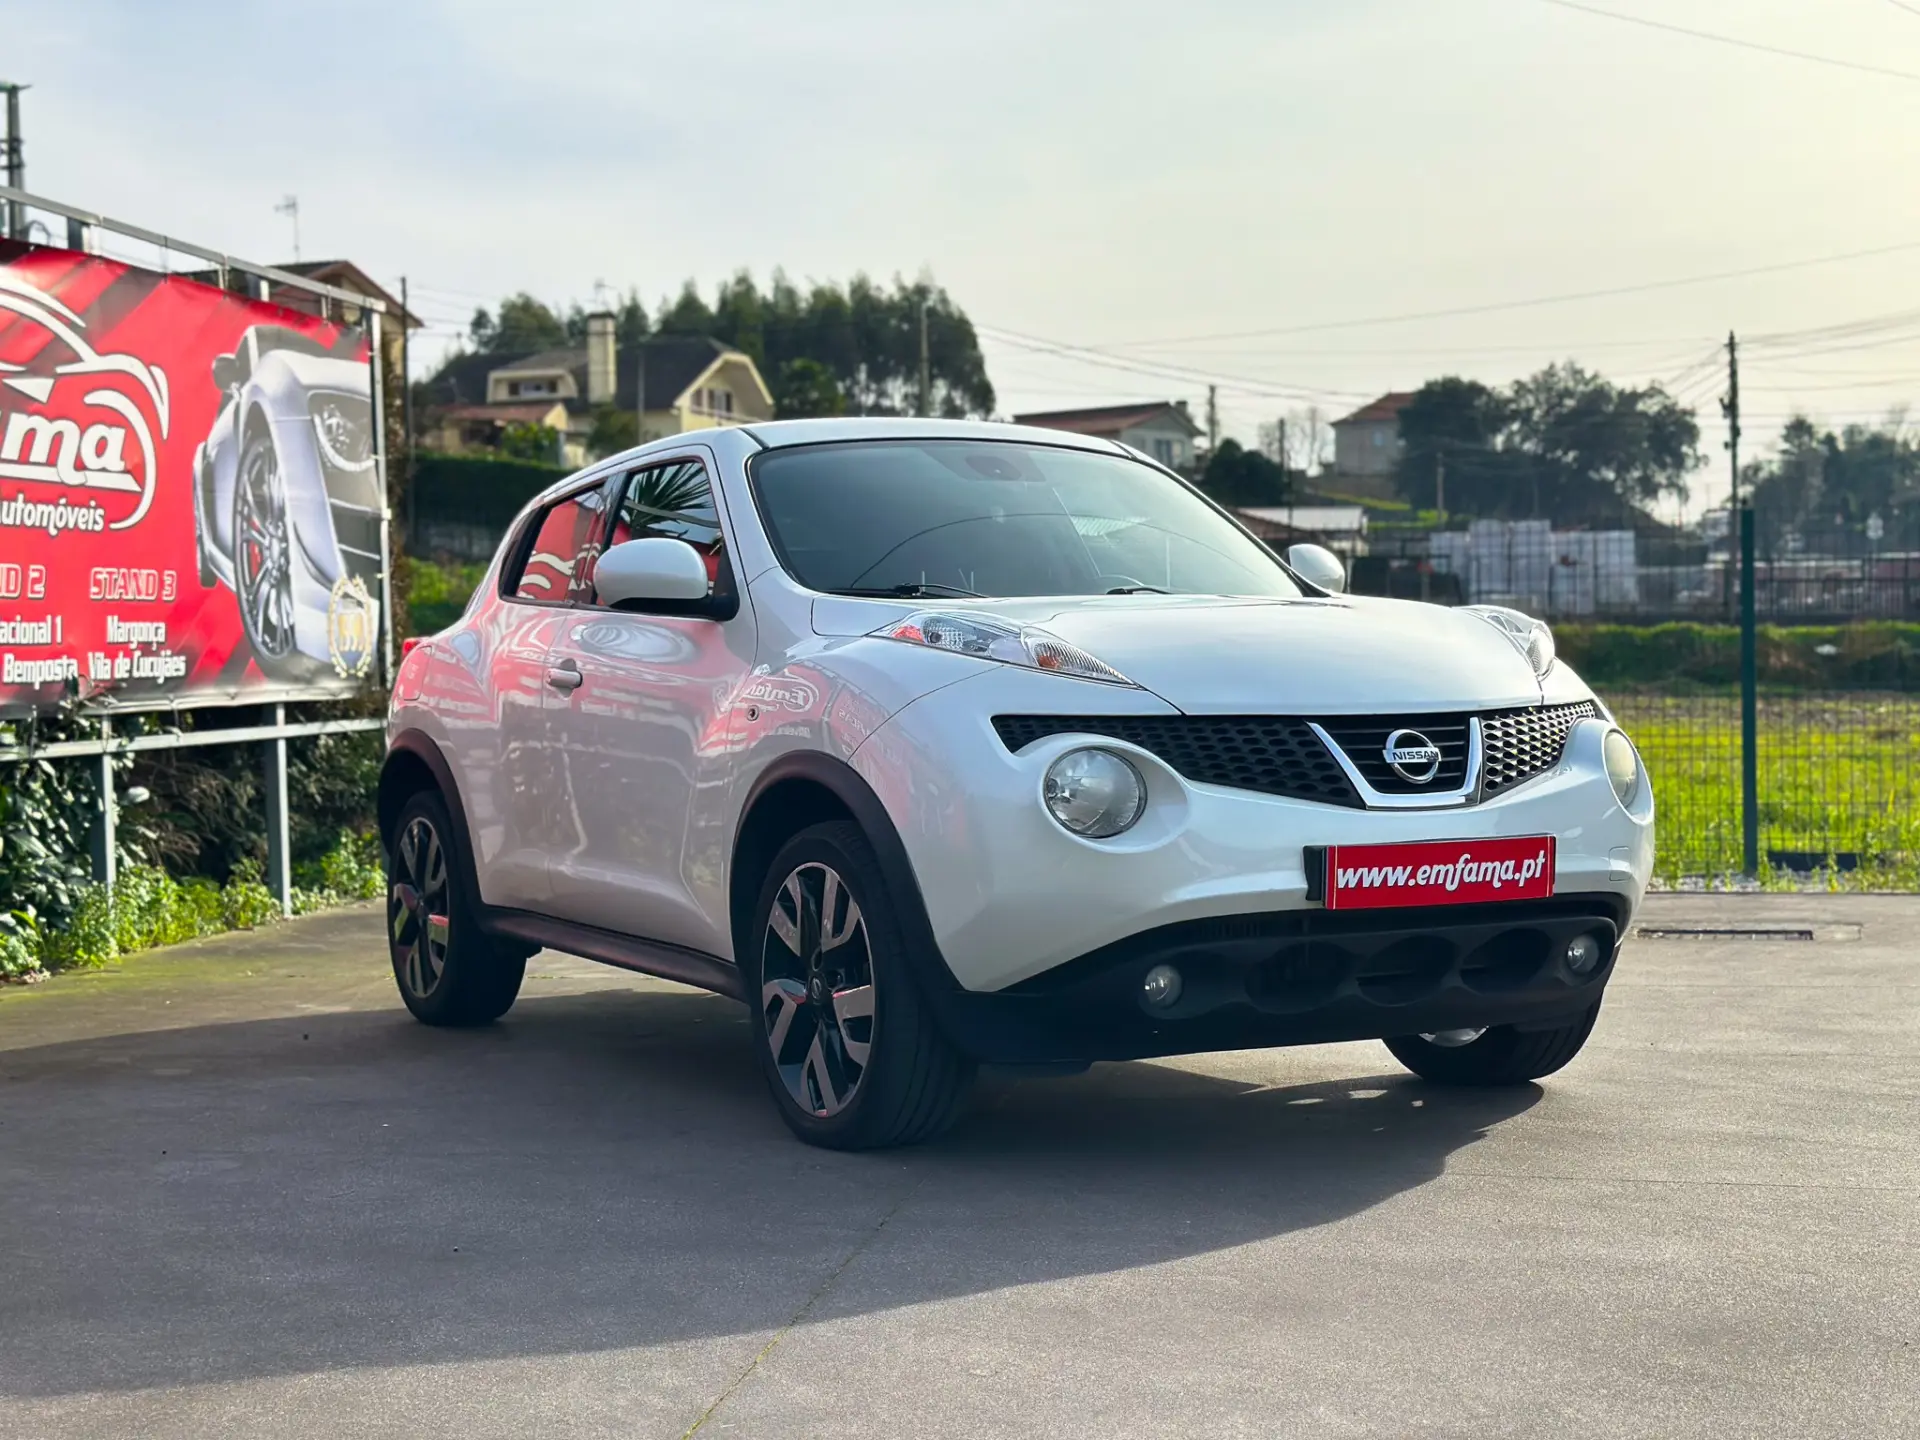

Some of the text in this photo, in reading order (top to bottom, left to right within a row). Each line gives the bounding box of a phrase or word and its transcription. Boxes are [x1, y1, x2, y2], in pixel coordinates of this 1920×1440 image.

[0, 410, 127, 486] ma
[0, 493, 104, 536] utomóveis
[27, 564, 46, 599] 2
[90, 567, 177, 601] STAND 3
[3, 653, 78, 690] Bemposta
[88, 652, 112, 681] Vila
[114, 651, 131, 679] de
[1392, 750, 1439, 761] NISSAN
[1337, 849, 1546, 891] www.emfama.pt
